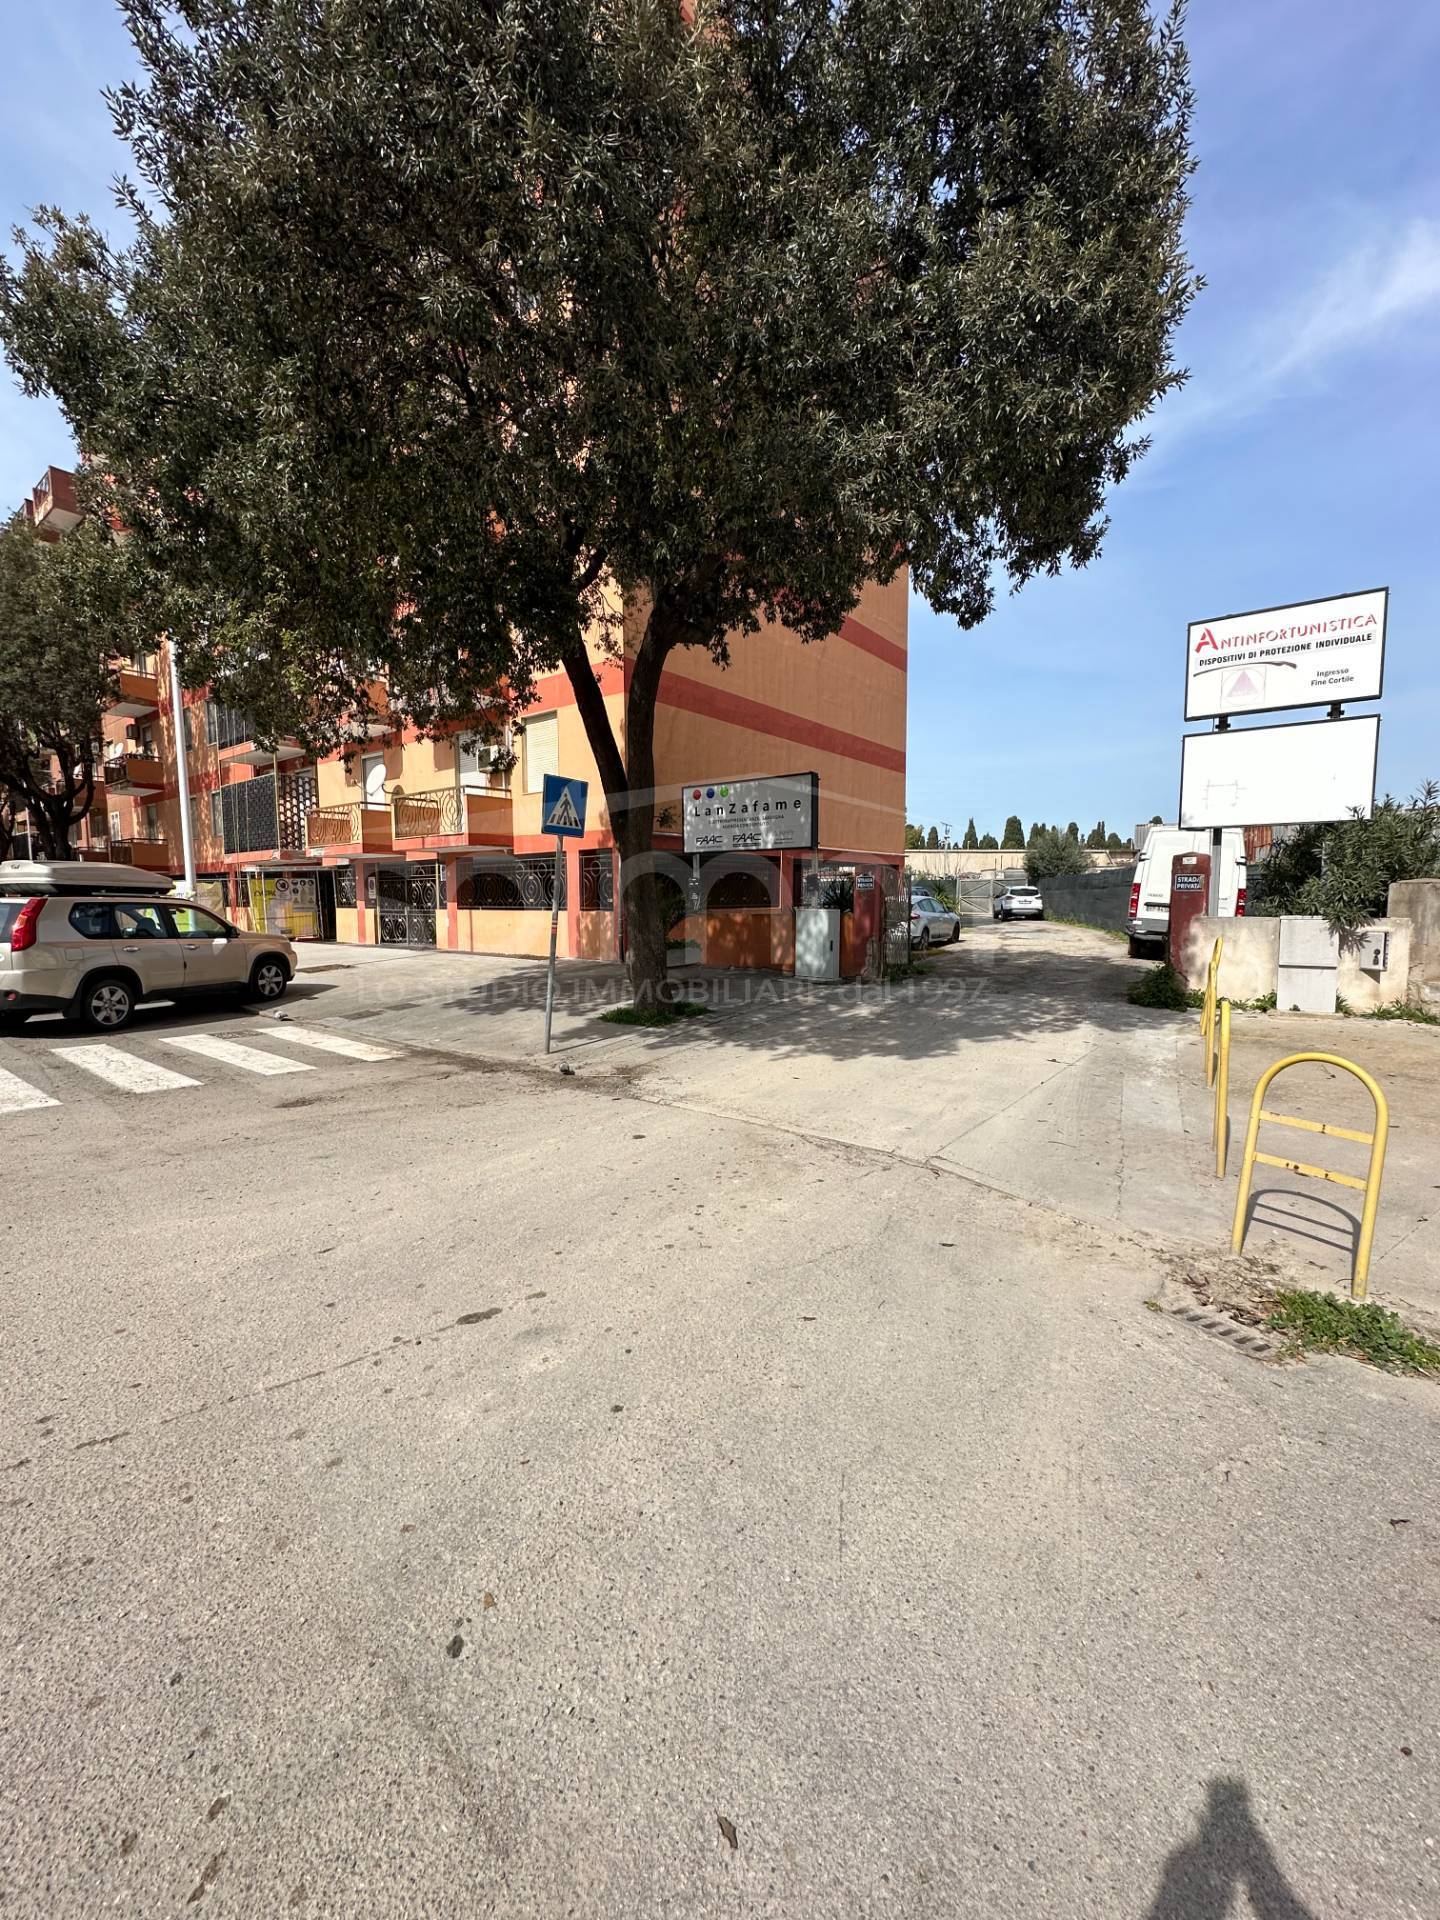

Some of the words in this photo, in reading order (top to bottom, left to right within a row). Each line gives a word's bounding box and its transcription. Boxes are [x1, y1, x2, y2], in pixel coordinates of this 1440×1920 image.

[1195, 614, 1377, 653] ANTINFORTUNISTICA
[1199, 653, 1246, 667] DISPOSITIVI
[1248, 651, 1257, 659] DI
[1260, 642, 1312, 656] PROTEZIONE
[1316, 633, 1372, 648] INDIVIDUALE
[1316, 668, 1349, 678] Ingresso
[1311, 679, 1327, 687] Fine
[1328, 676, 1355, 685] Cortile
[695, 835, 723, 844] FAAC
[732, 833, 762, 843] FAAC
